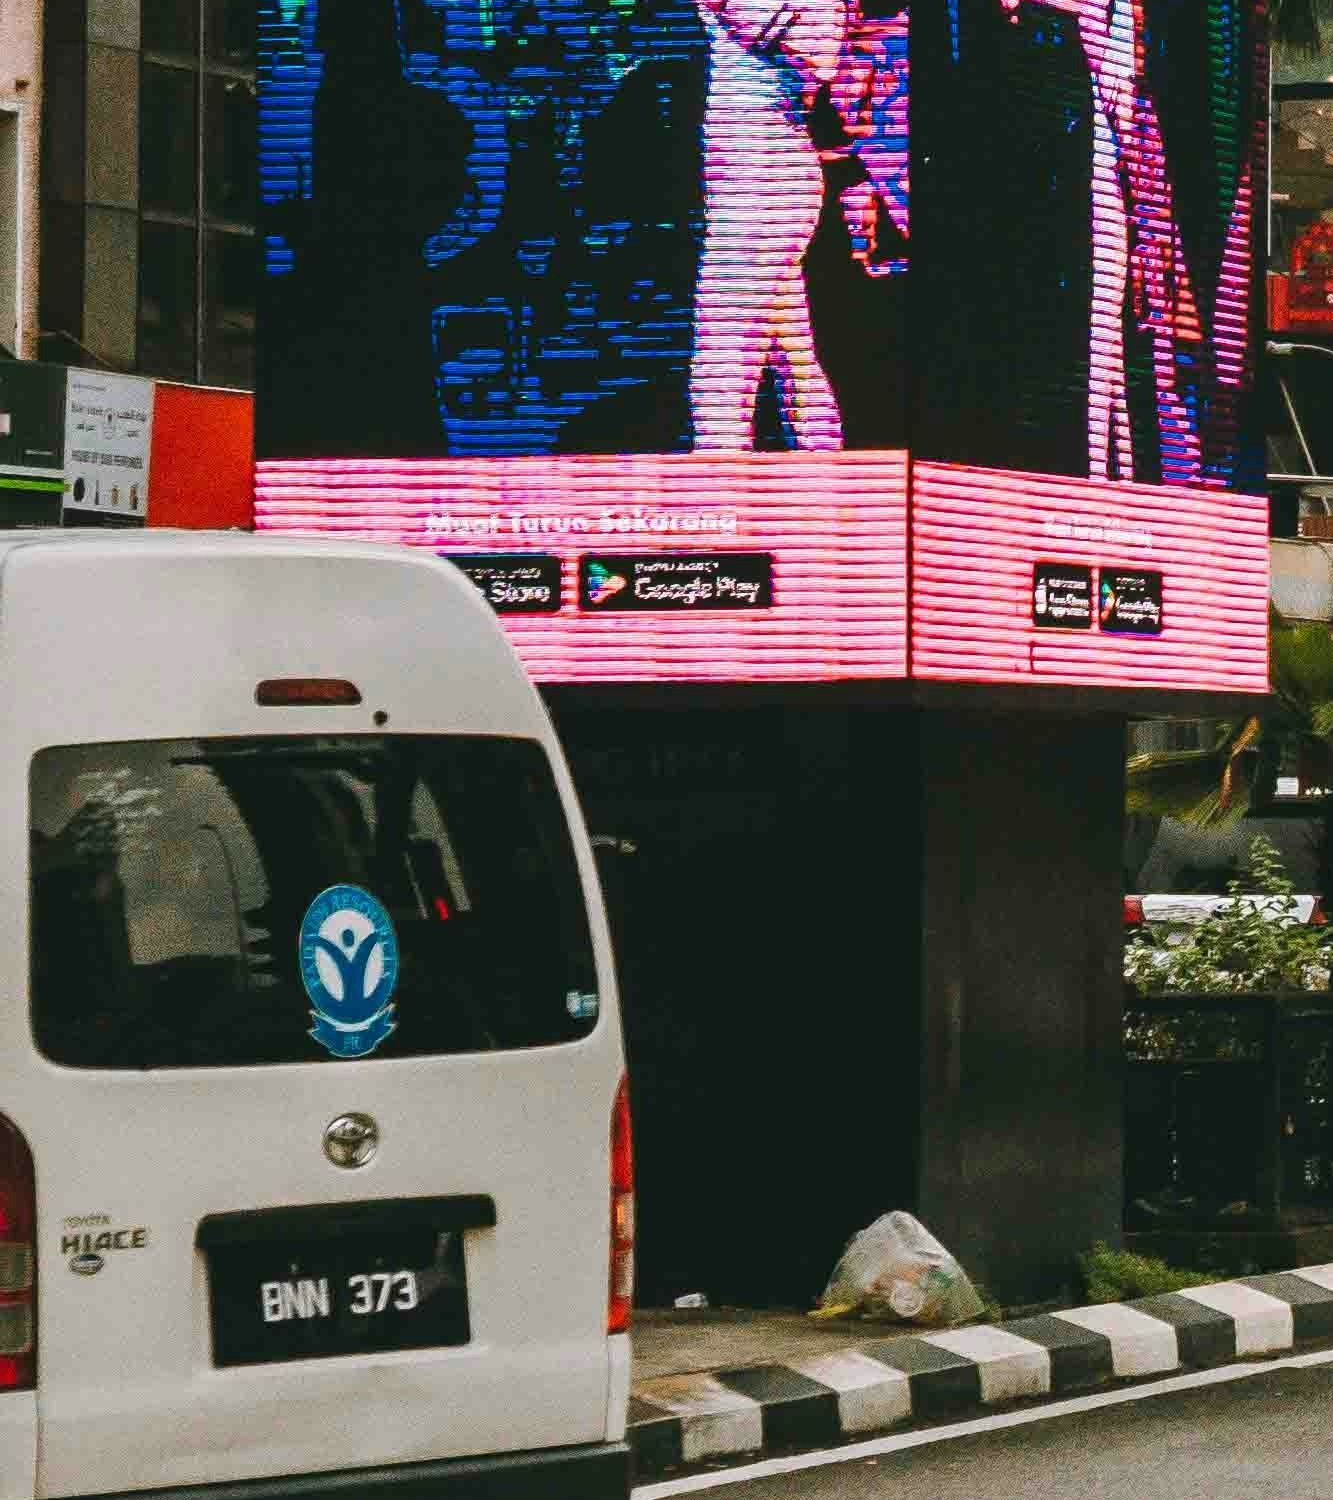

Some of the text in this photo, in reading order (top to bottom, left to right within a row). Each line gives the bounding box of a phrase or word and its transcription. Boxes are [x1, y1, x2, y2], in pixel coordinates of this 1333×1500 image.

[633, 575, 761, 603] Google Play
[62, 1229, 146, 1254] HIACE
[261, 1270, 419, 1322] BNN 373
